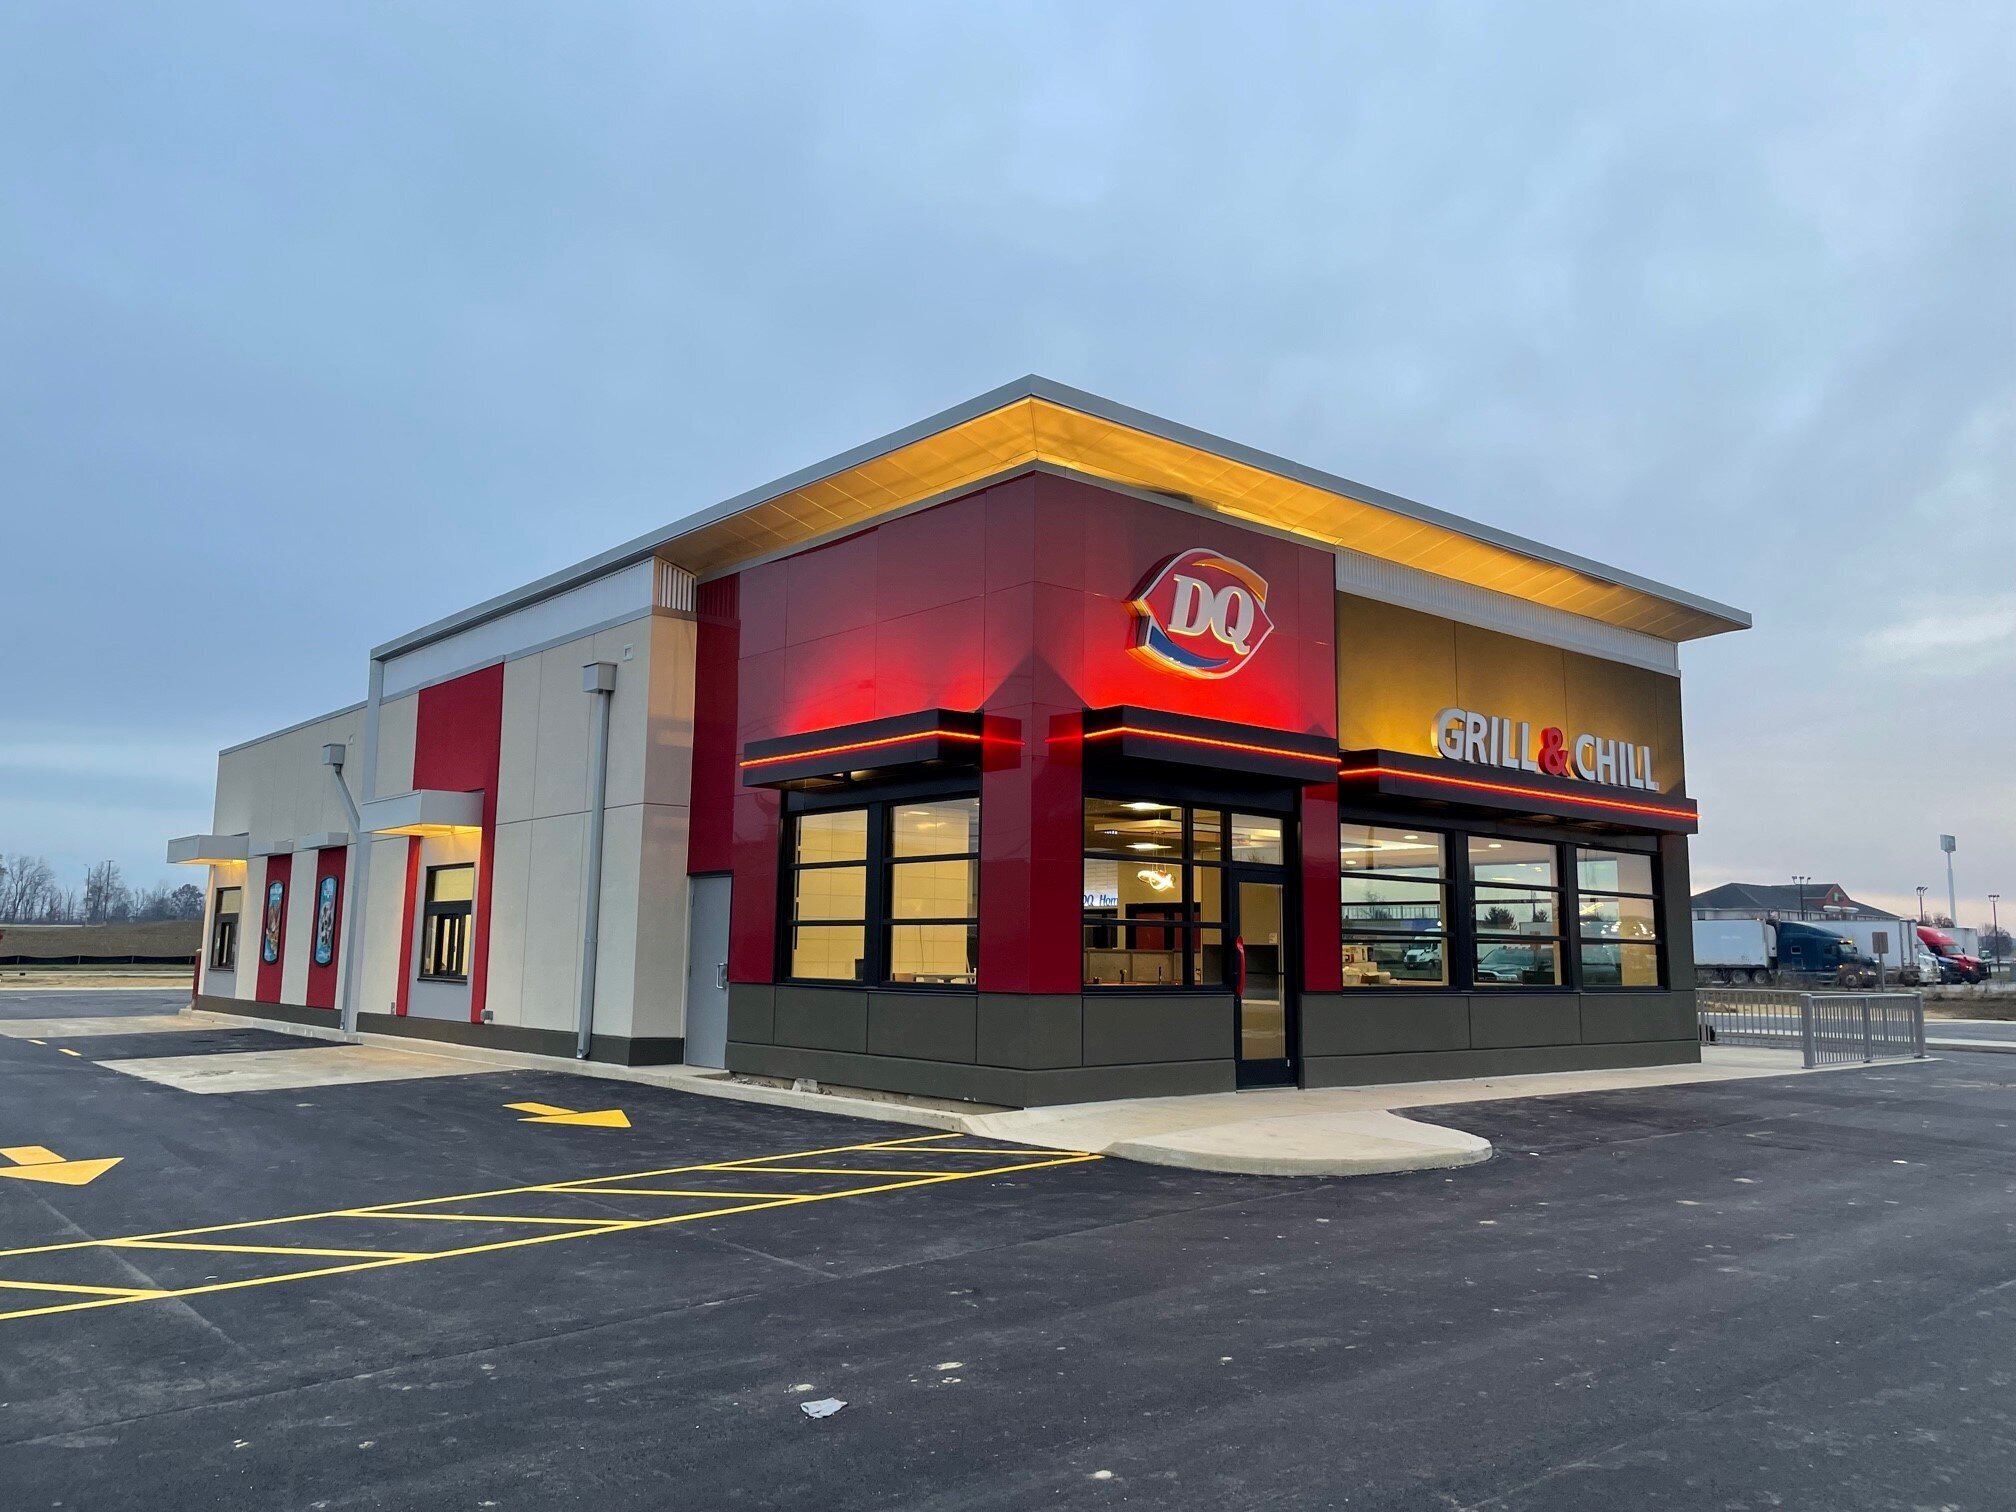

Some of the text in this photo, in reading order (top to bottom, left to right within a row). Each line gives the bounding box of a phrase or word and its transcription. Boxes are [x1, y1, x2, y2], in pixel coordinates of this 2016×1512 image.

[1167, 574, 1255, 656] DQ
[1433, 707, 1660, 791] GRILL & CHILL
